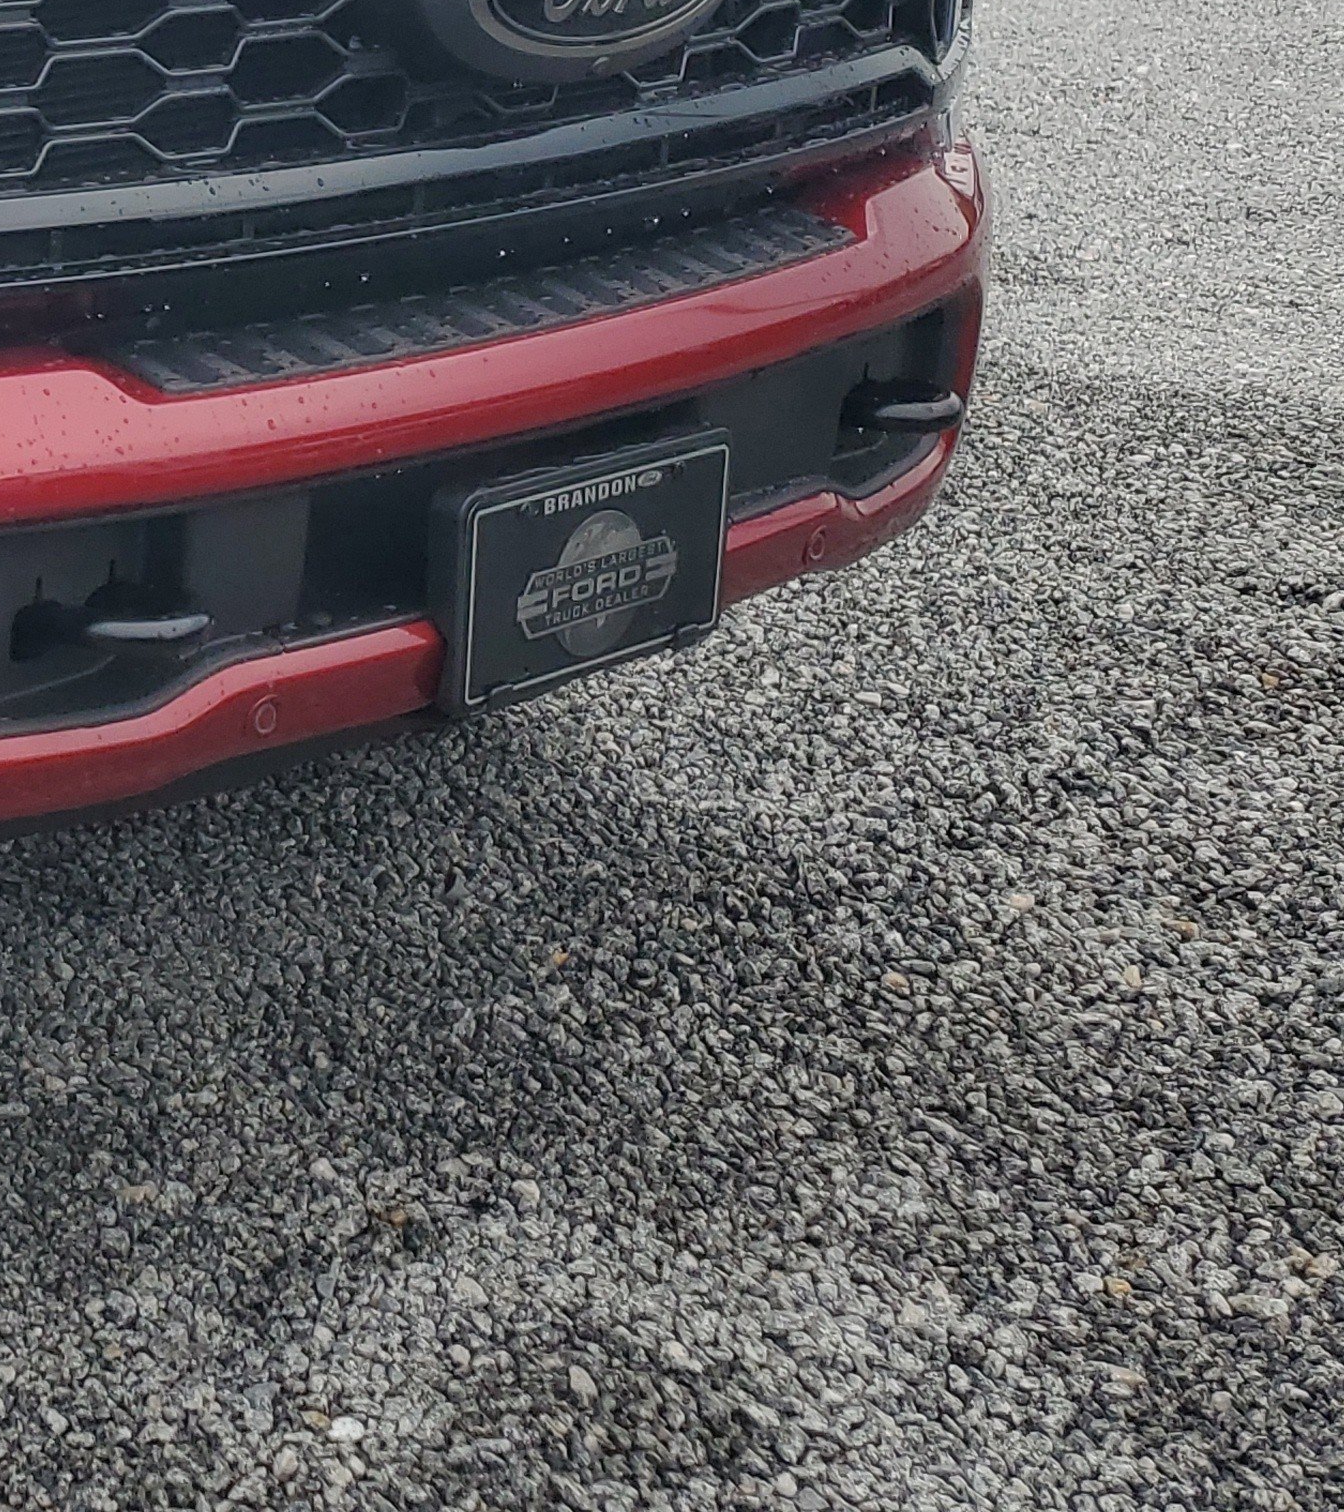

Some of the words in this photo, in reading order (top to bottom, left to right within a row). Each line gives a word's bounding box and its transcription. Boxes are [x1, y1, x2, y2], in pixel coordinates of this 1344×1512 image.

[544, 474, 637, 516] BRANDON
[535, 561, 597, 588] WORLD'S
[601, 543, 666, 569] LARGEST
[553, 564, 641, 609] FORD
[545, 605, 589, 626] TRUCK
[596, 585, 649, 611] DEALER
